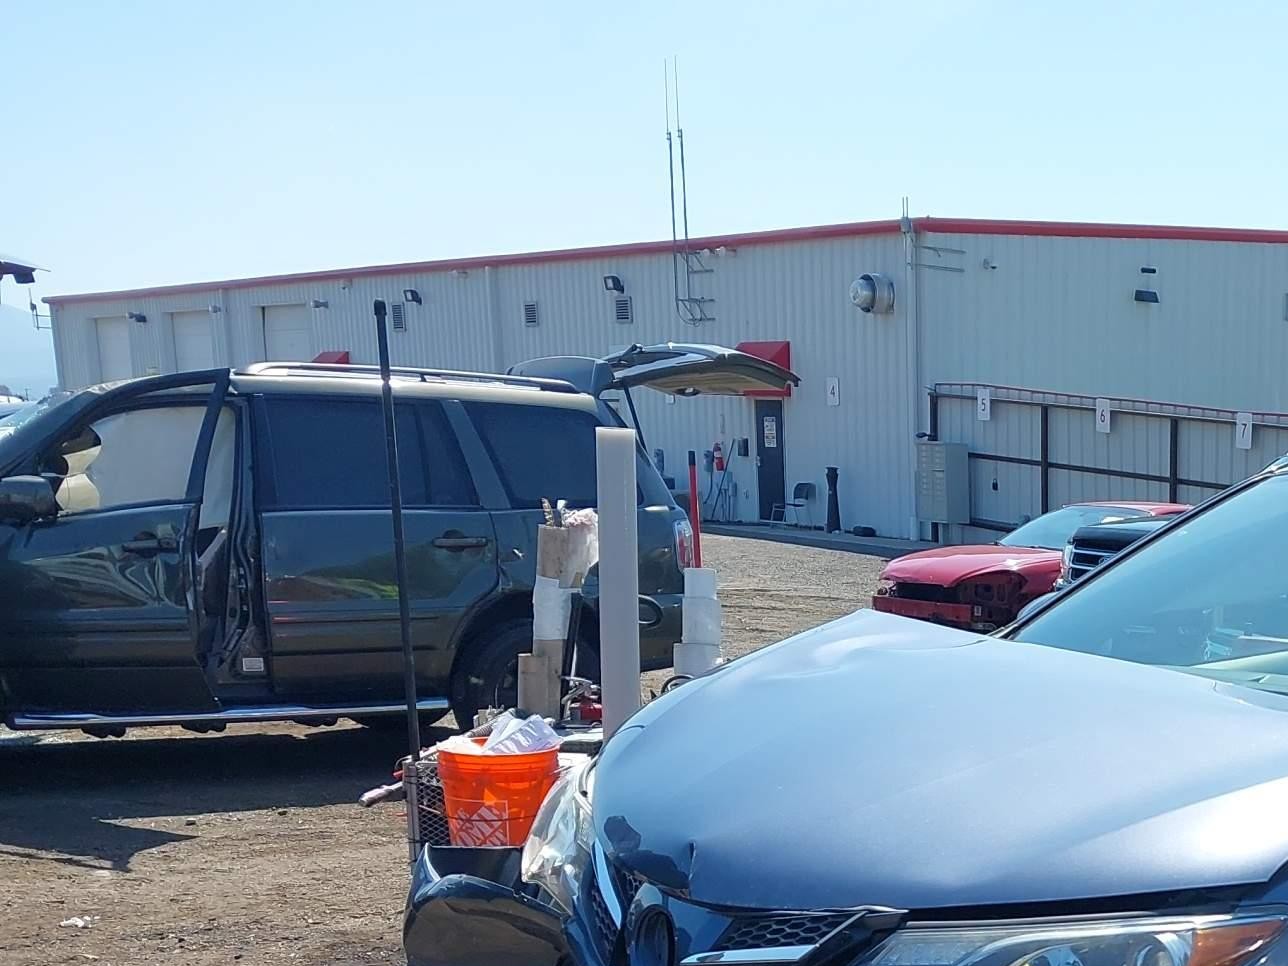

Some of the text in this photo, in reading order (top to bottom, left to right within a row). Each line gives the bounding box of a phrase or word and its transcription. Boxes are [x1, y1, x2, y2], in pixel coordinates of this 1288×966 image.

[829, 384, 837, 398] 4
[981, 398, 987, 412] 5
[1099, 409, 1106, 423] 6
[1241, 423, 1248, 439] 7
